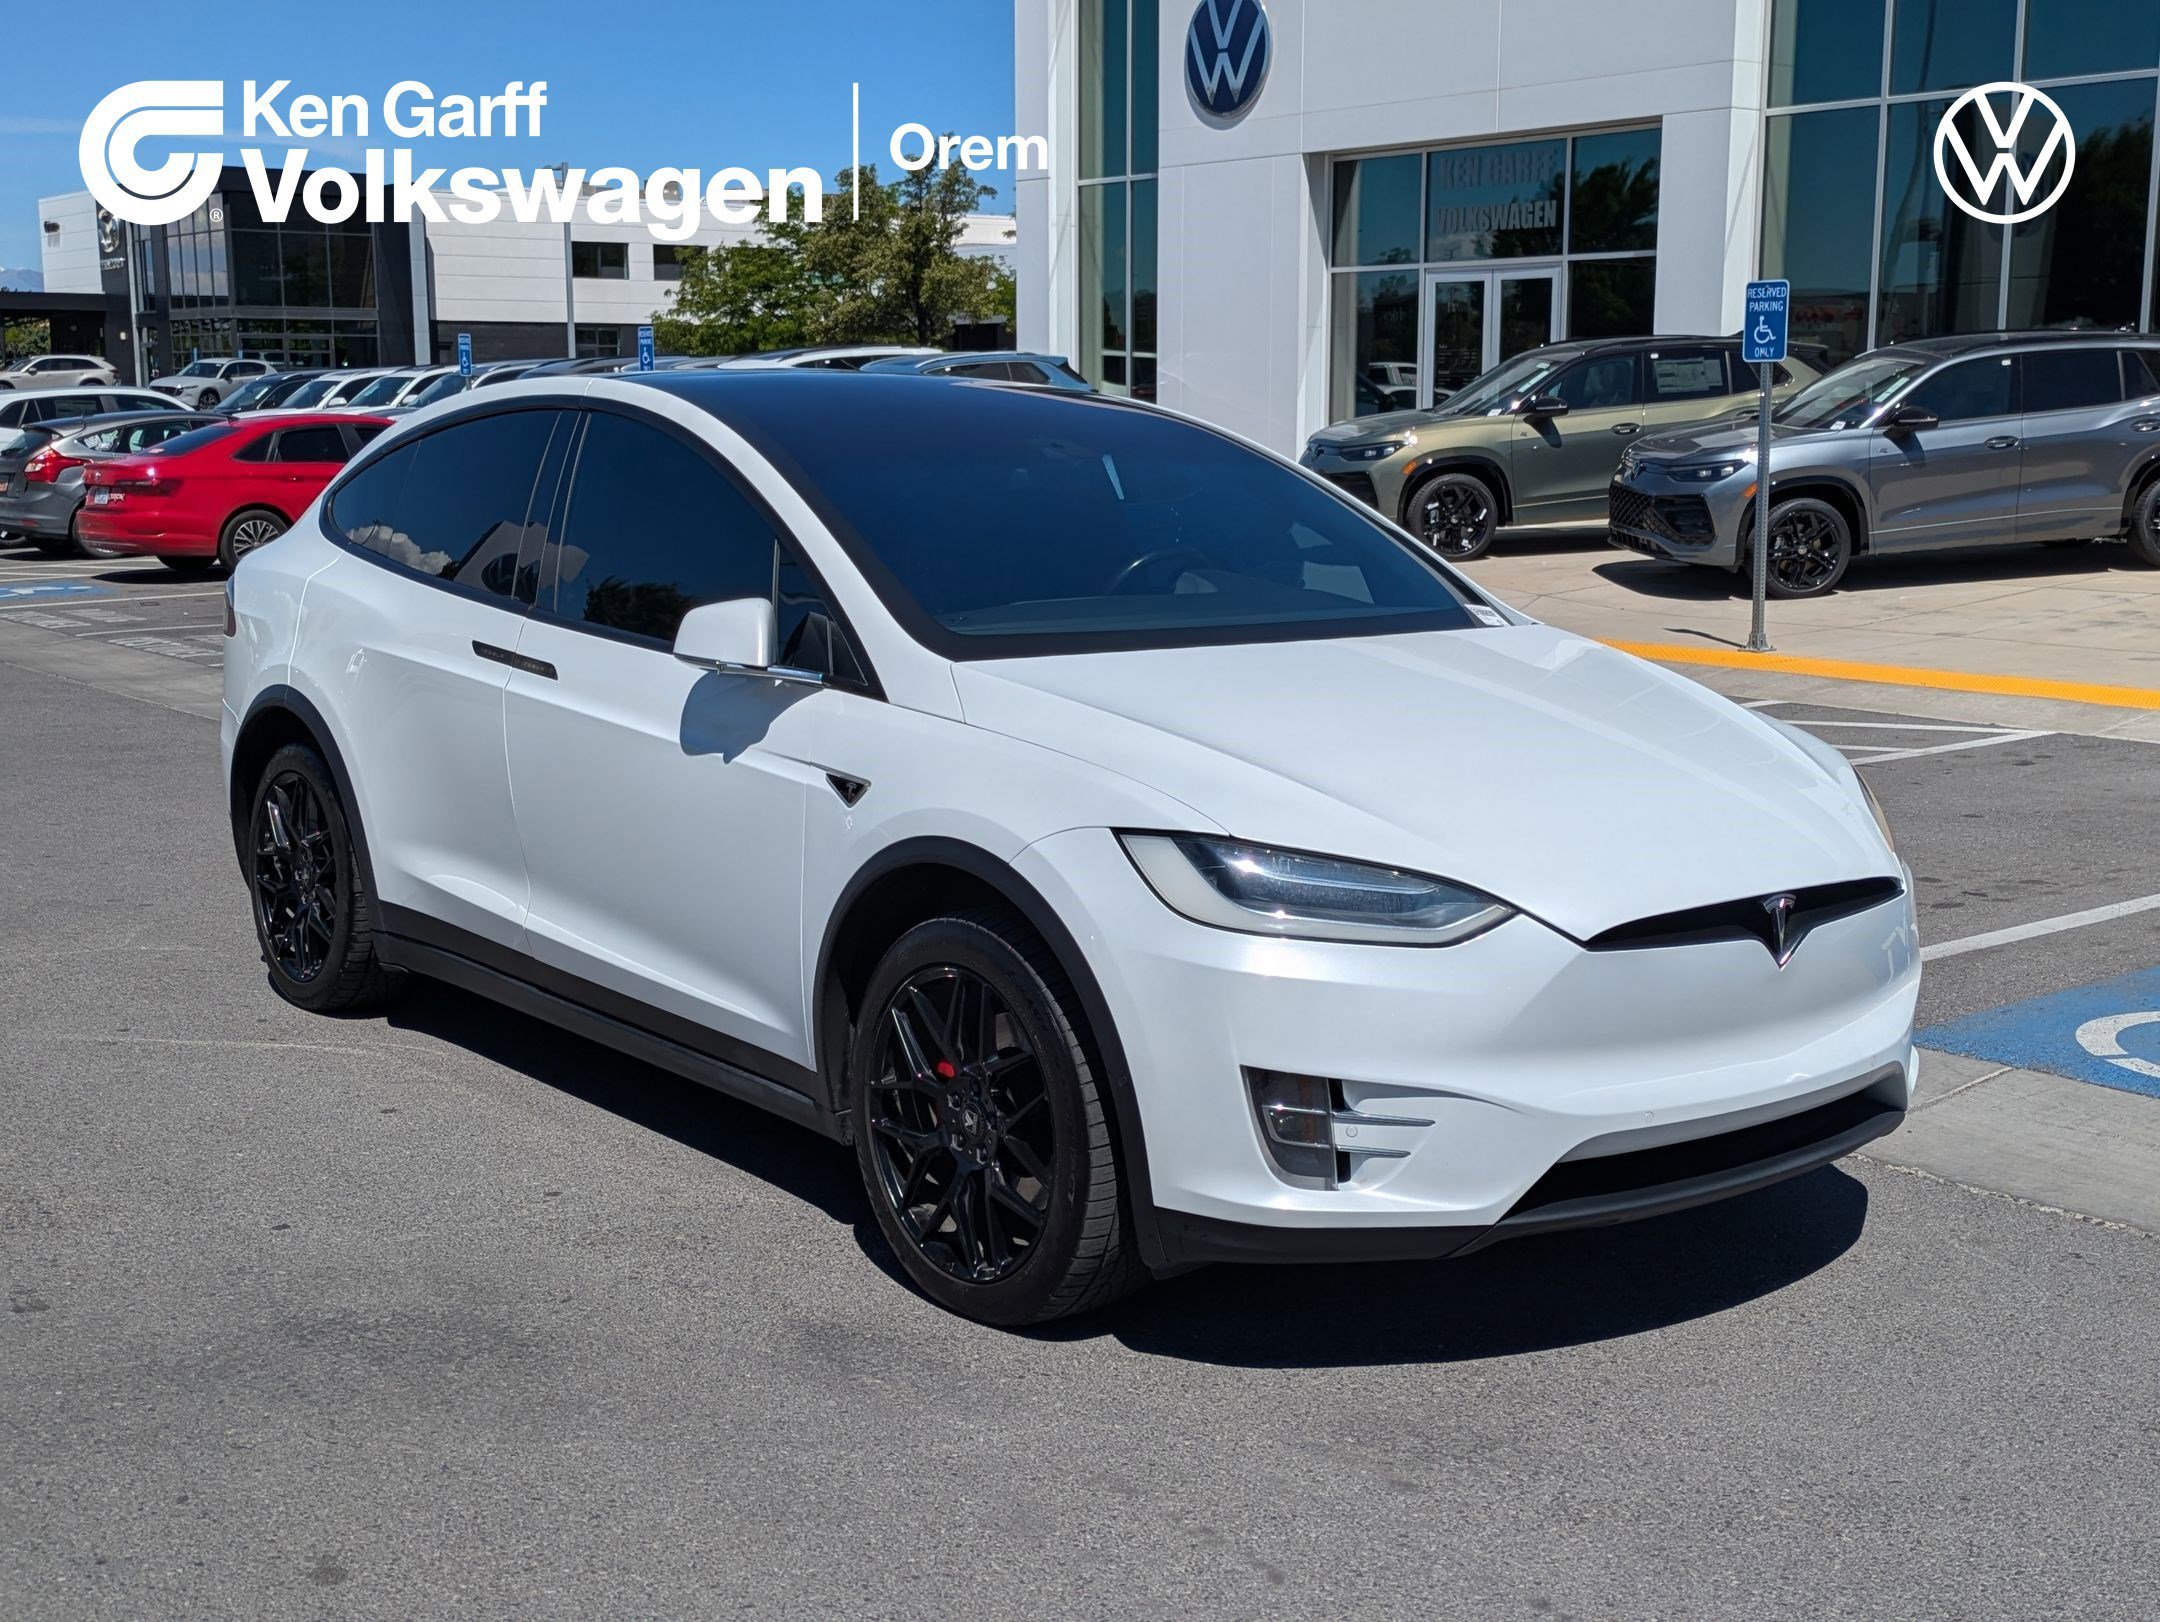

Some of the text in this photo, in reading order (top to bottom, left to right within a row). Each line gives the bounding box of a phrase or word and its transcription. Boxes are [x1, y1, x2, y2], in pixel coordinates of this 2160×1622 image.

[1440, 150, 1555, 189] KEN GARFF
[1437, 199, 1557, 234] VOLKSWAGEN
[1747, 286, 1787, 299] RESERVED
[1749, 300, 1784, 312] PARKING
[1754, 346, 1775, 358] ONLY
